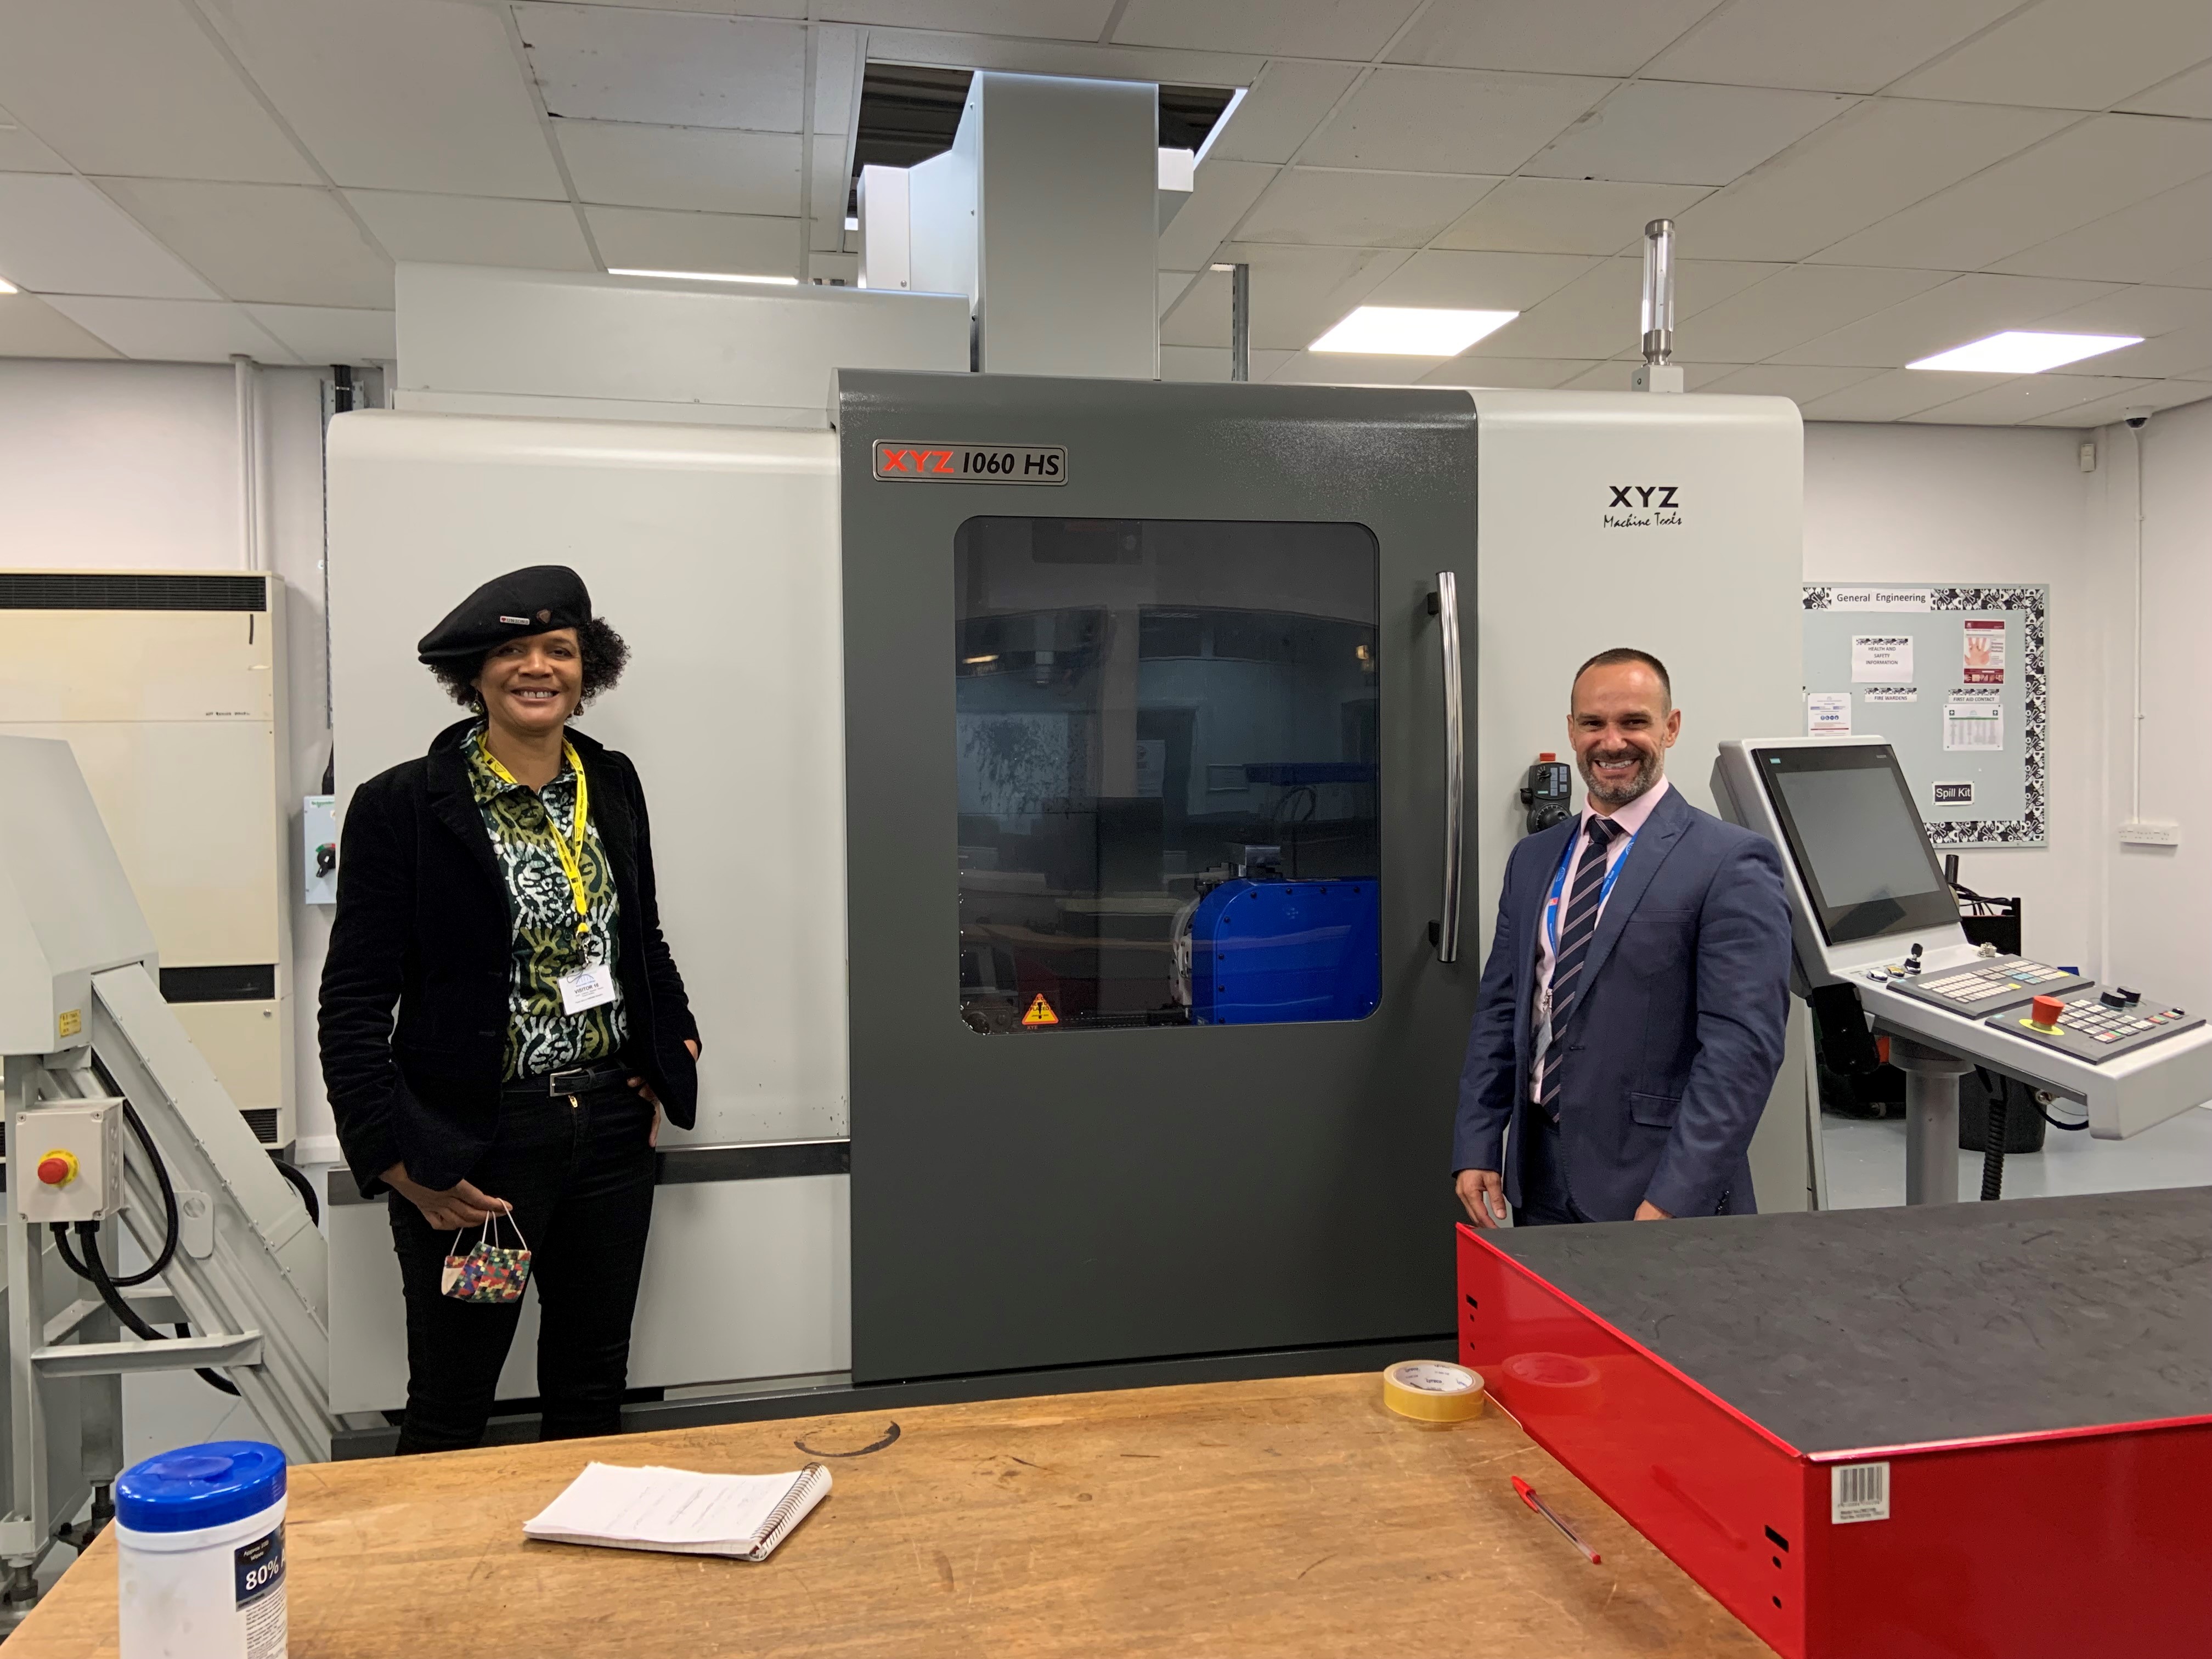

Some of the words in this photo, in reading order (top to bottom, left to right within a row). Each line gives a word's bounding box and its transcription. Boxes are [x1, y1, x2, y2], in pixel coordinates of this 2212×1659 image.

[882, 449, 954, 473] XYZ
[963, 452, 1014, 475] 1060
[1024, 454, 1059, 476] HS
[1609, 486, 1679, 508] XYZ
[1604, 514, 1651, 528] Machine
[1654, 511, 1682, 526] Tools
[1837, 594, 1870, 602] General
[1876, 593, 1926, 603] Engineering
[1936, 788, 1956, 799] Spill
[1958, 787, 1971, 797] Kit
[574, 985, 593, 994] VISITOR
[246, 1556, 279, 1590] 80%
